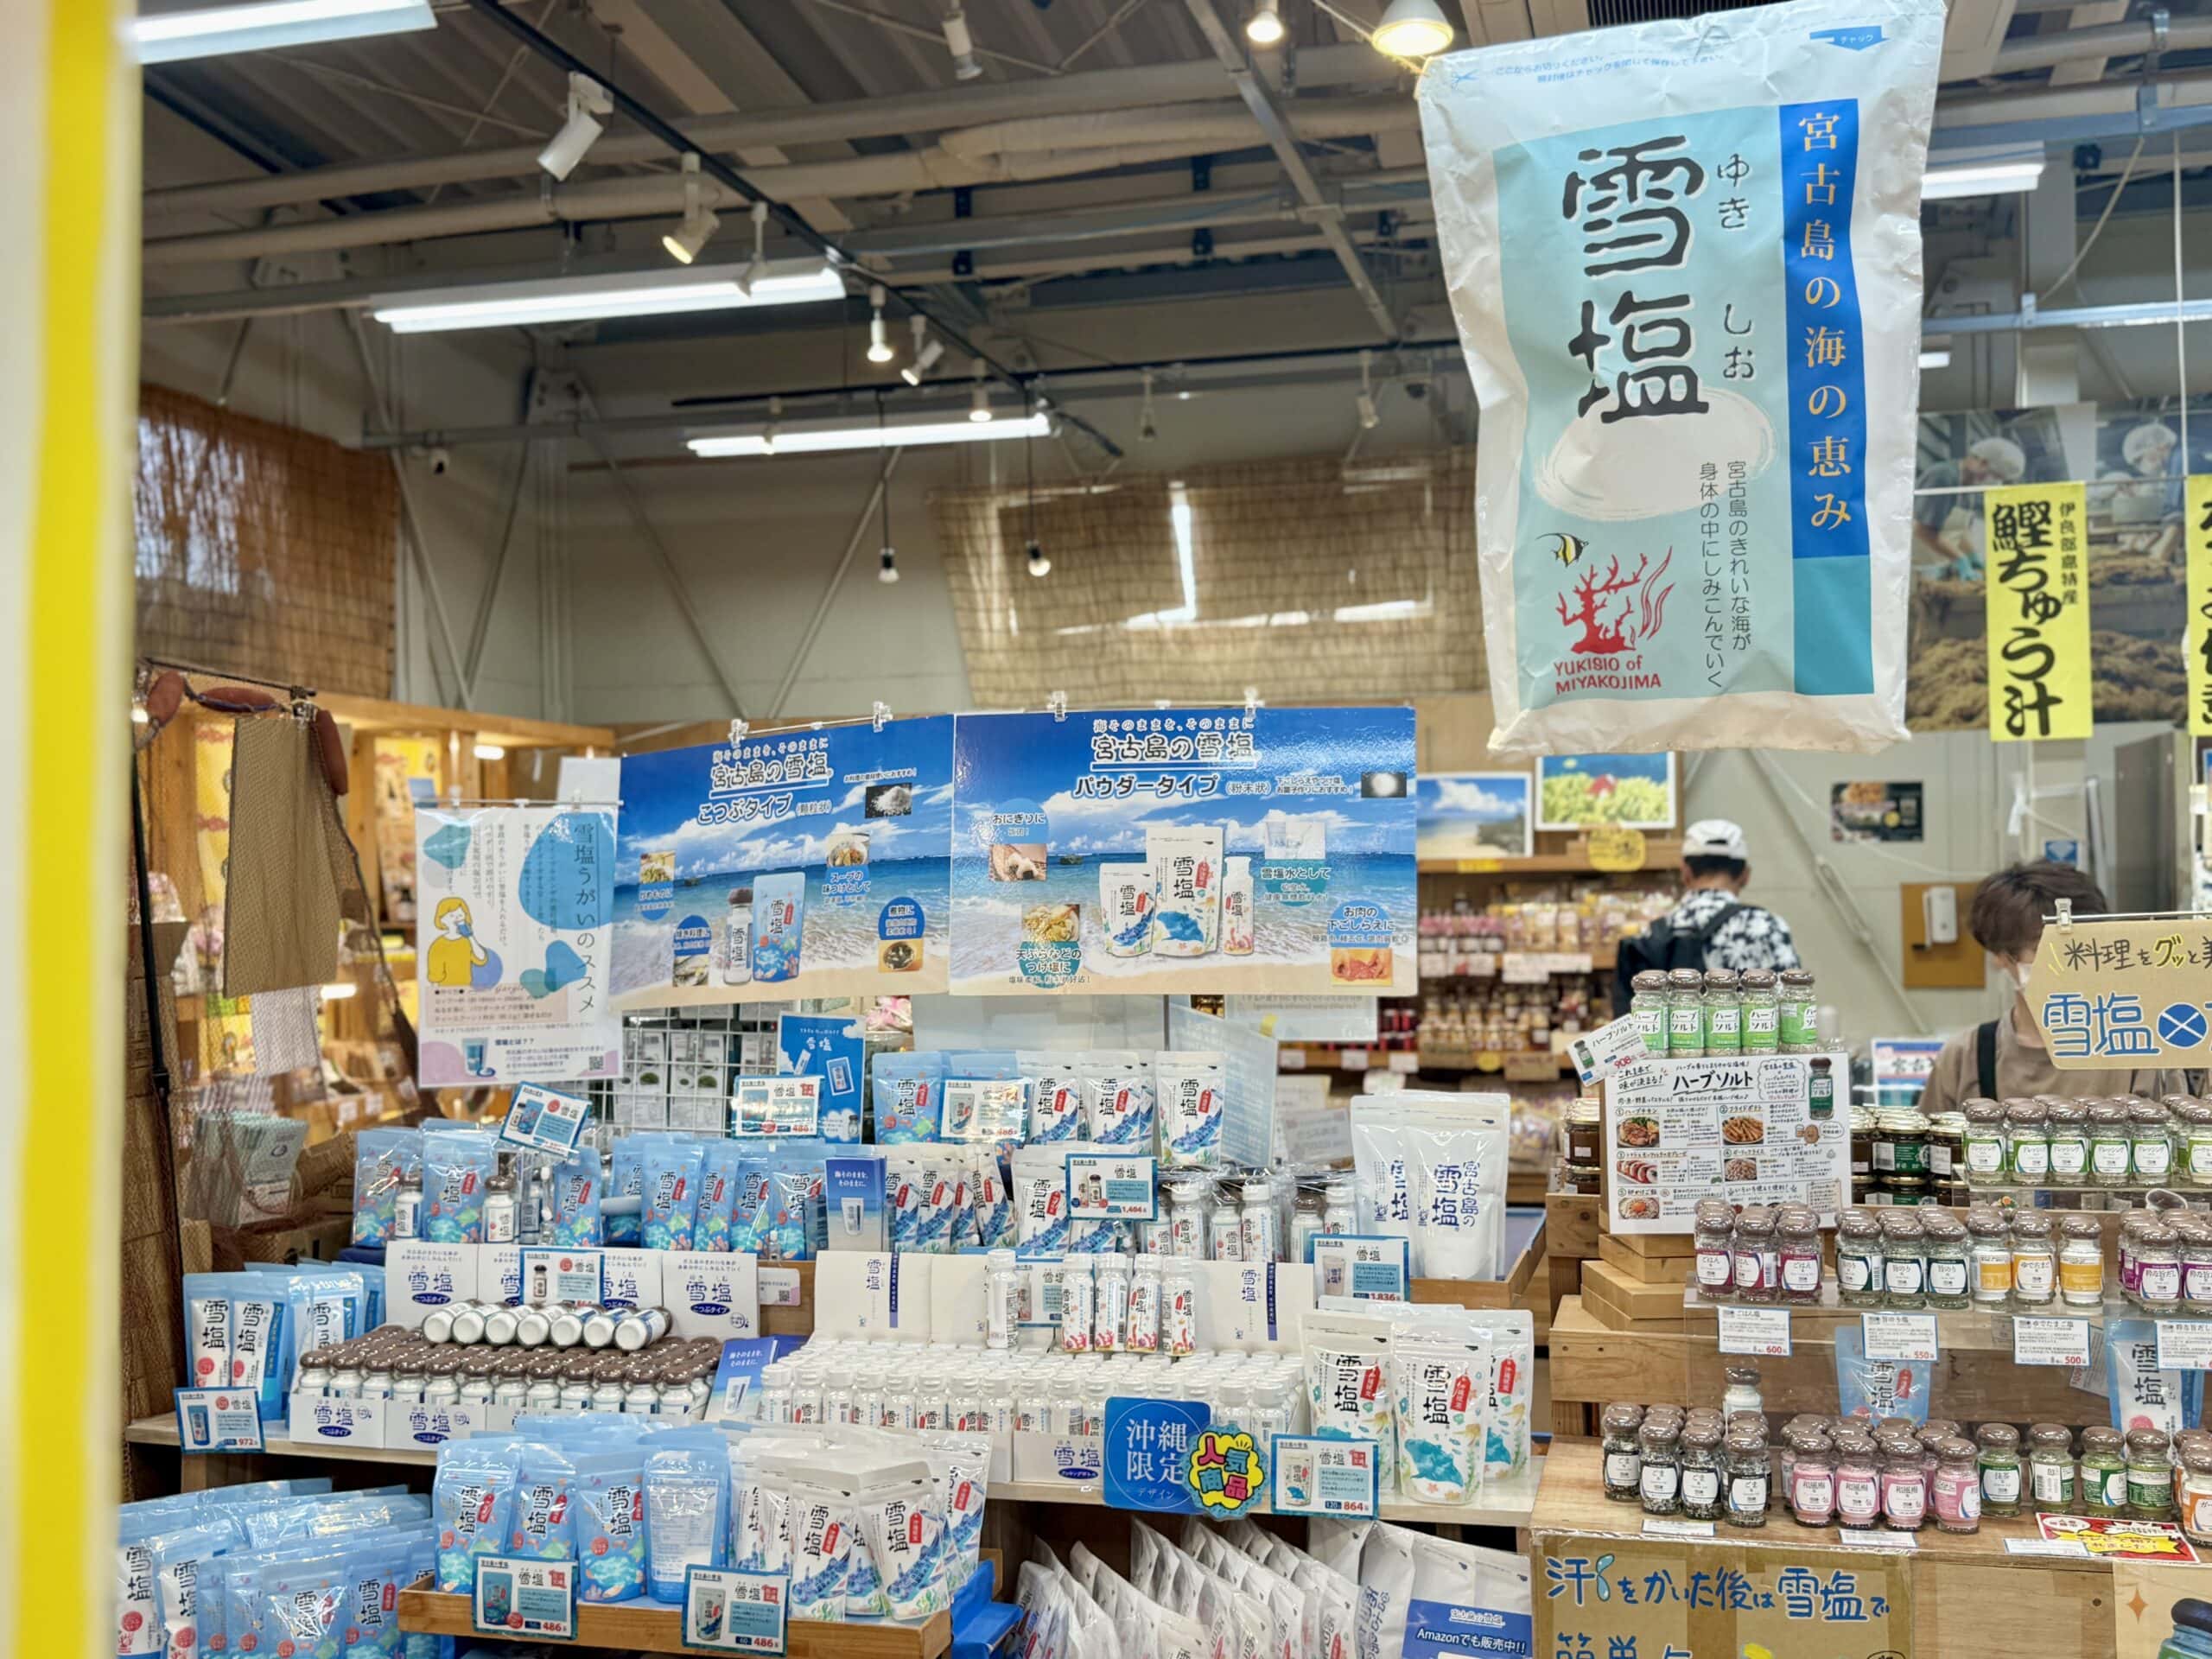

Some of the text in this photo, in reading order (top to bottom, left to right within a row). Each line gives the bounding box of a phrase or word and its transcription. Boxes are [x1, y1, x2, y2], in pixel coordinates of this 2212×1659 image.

[1562, 134, 1710, 423] 雪塩
[1716, 154, 1755, 380] ゆき しお
[1799, 111, 1853, 532] 宮古島の海の恵み
[1700, 462, 1725, 688] 身体の中にしみこんでいく
[1727, 461, 1751, 651] 宮古島のきれいな海が
[1554, 656, 1643, 676] YUKISIO of
[1555, 673, 1662, 695] MIYAKOJIMA
[1091, 733, 1254, 762] 宮古島の雪塩
[710, 752, 830, 790] 宮古島の雪塩
[1074, 775, 1220, 798] パウダータイプ
[697, 794, 792, 825] こつぶタイプ
[993, 813, 1046, 825] おにぎりに
[1173, 856, 1196, 899] 雪塩
[1261, 867, 1332, 880] 雪塩水として
[573, 823, 597, 1013] 雪塩うがいのススメ
[1343, 906, 1378, 918] お肉の
[2044, 991, 2161, 1057] 雪塩
[1613, 1055, 1633, 1069] 908
[1672, 1071, 1754, 1090] ハーブソルト
[898, 1078, 916, 1117] 雪塩
[1037, 1077, 1056, 1117] 雪塩
[1180, 1078, 1200, 1117] 雪塩
[656, 1171, 677, 1211] 雪塩
[699, 1171, 718, 1211] 雪塩
[741, 1171, 762, 1211] 雪塩
[920, 1170, 938, 1211] 雪塩
[1114, 1166, 1137, 1179] 雪塩
[564, 1174, 584, 1212] 雪塩
[1029, 1179, 1052, 1220] 雪塩
[1432, 1164, 1462, 1226] 雪塩
[1459, 1160, 1480, 1227] 宮古島の
[867, 1258, 881, 1290] 雪塩
[1356, 1249, 1382, 1262] 雪塩
[408, 1271, 454, 1293] 雪塩
[686, 1281, 733, 1303] 雪塩
[1242, 1269, 1258, 1302] 雪塩
[202, 1300, 230, 1350] 雪塩
[236, 1302, 264, 1353] 雪塩
[1766, 1345, 1783, 1354] 600
[1914, 1351, 1930, 1359] 550
[2064, 1356, 2082, 1365] 500
[1334, 1354, 1363, 1414] 雪塩
[1423, 1363, 1452, 1426] 雪塩
[2132, 1344, 2164, 1408] 雪塩
[314, 1405, 354, 1426] 雪塩
[409, 1412, 452, 1433] 雪塩
[238, 1437, 254, 1446] 972
[1126, 1418, 1188, 1452] 沖縄
[1053, 1446, 1103, 1469] 雪塩
[1126, 1450, 1185, 1484] 限定
[1197, 1435, 1251, 1476] 人気
[1319, 1452, 1346, 1466] 雪塩
[458, 1485, 481, 1536] 雪塩
[526, 1484, 555, 1536] 雪塩
[608, 1485, 634, 1538] 雪塩
[1136, 1486, 1176, 1499] デザイン
[1344, 1501, 1365, 1511] 864
[803, 1504, 830, 1557] 雪塩
[887, 1500, 907, 1554] 雪塩
[127, 1546, 153, 1601] 雪塩
[173, 1559, 199, 1618] 雪塩
[518, 1571, 544, 1586] 雪塩
[1545, 1553, 1891, 1623] 汗をかいた後は雪塩で
[359, 1578, 382, 1626] 雪塩
[734, 1586, 760, 1601] 雪塩
[543, 1622, 562, 1631] 486
[753, 1637, 774, 1648] 486
[1416, 1628, 1527, 1655] Amazonでも販売中!!
